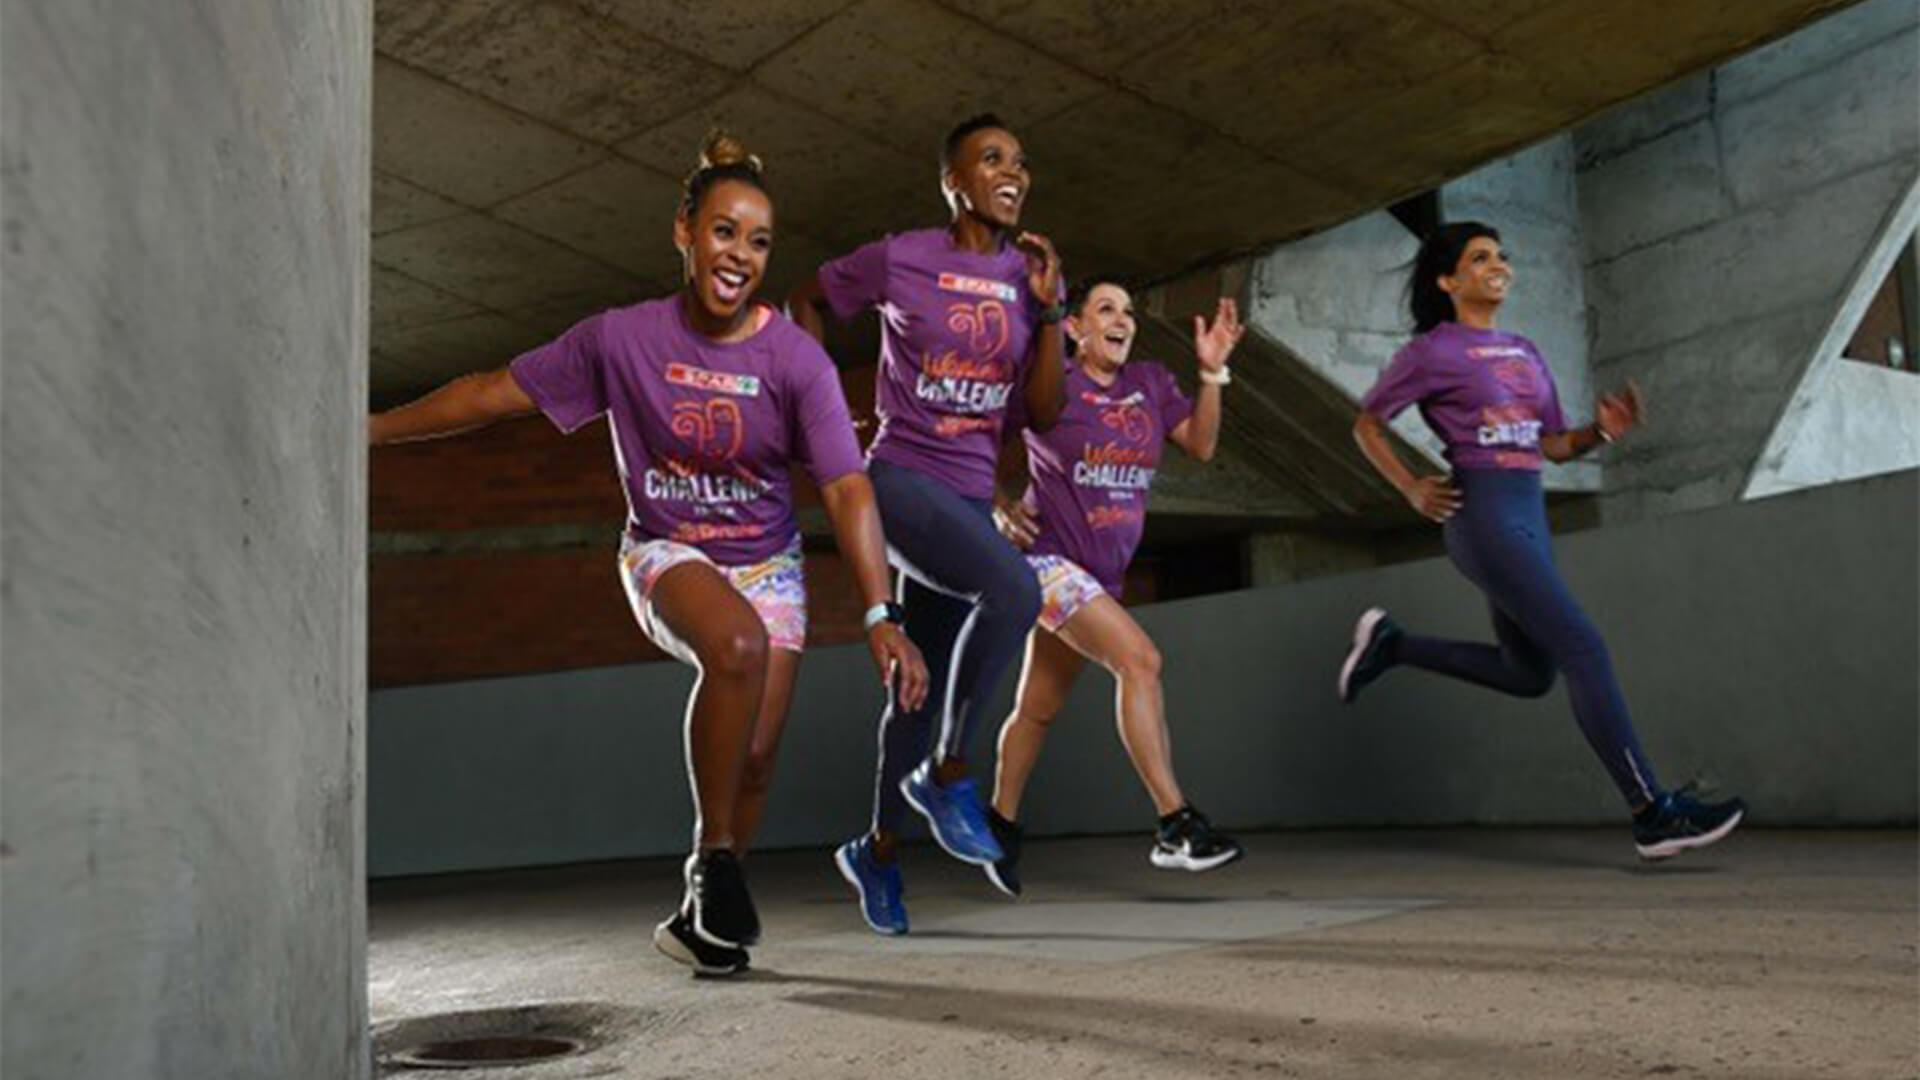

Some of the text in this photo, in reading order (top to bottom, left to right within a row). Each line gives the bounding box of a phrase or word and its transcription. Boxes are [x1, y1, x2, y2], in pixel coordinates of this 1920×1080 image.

[917, 374, 1014, 412] CHALLEN
[645, 468, 773, 502] CHALLEN
[1074, 461, 1156, 489] CHALLEN
